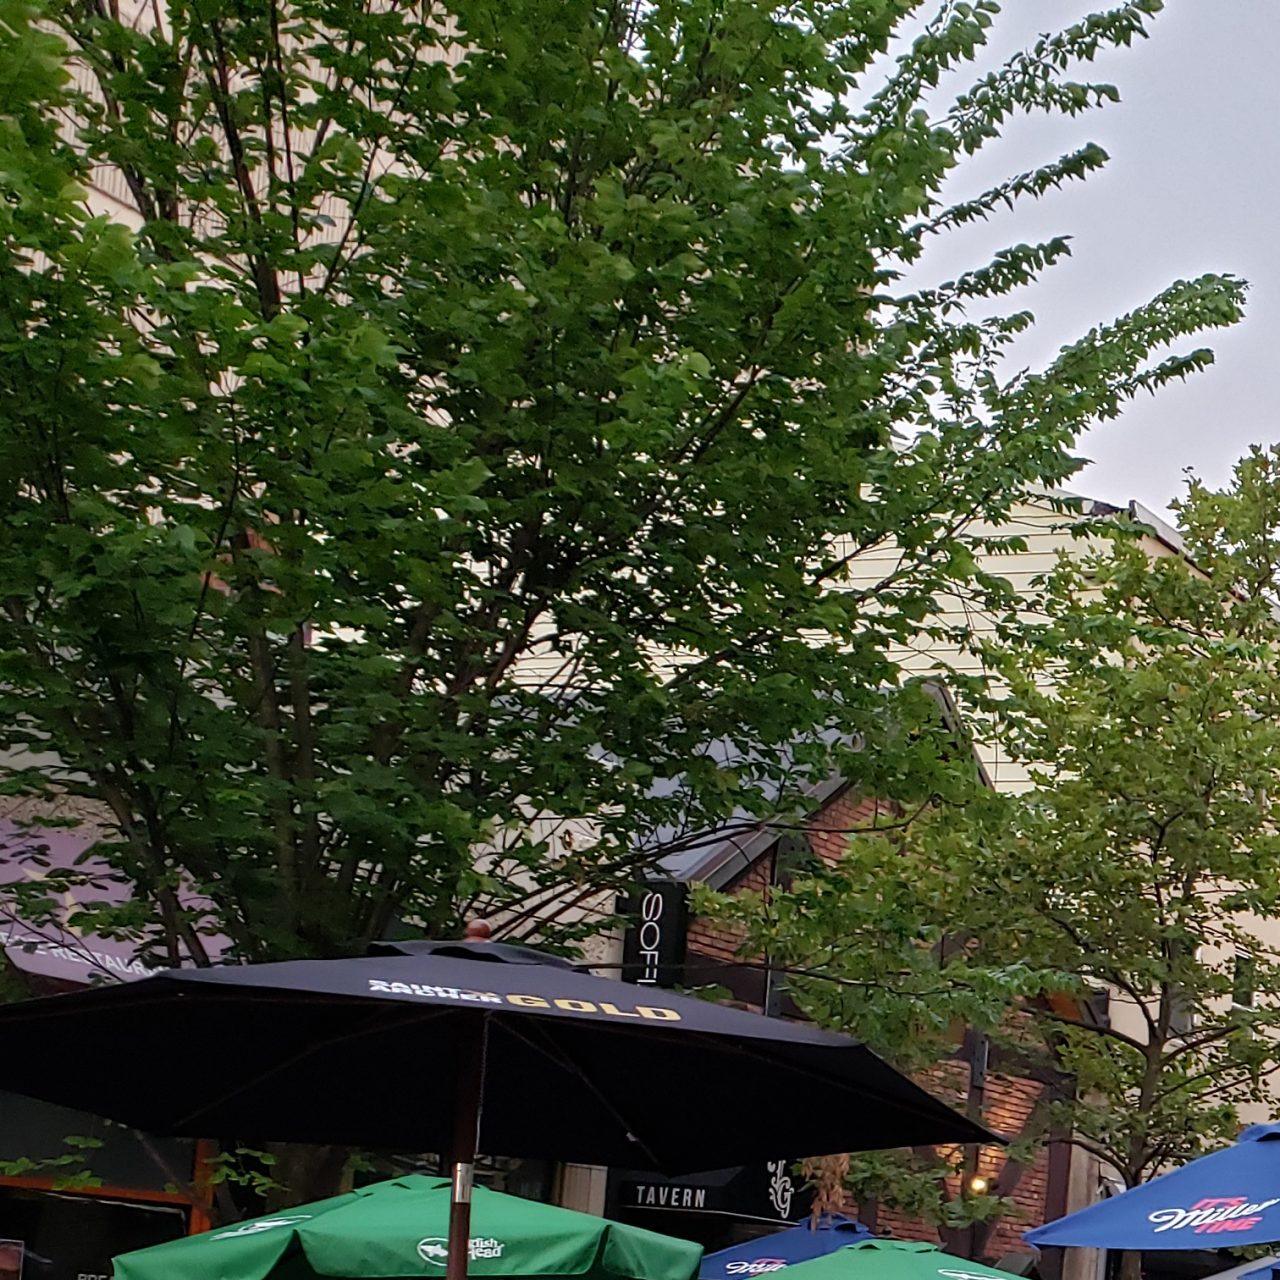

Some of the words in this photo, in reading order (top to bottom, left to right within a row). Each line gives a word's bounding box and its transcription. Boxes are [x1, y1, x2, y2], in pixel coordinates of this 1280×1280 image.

[507, 994, 682, 1021] GOLD
[636, 1186, 706, 1208] TAVERN
[1148, 1198, 1280, 1233] Miller
